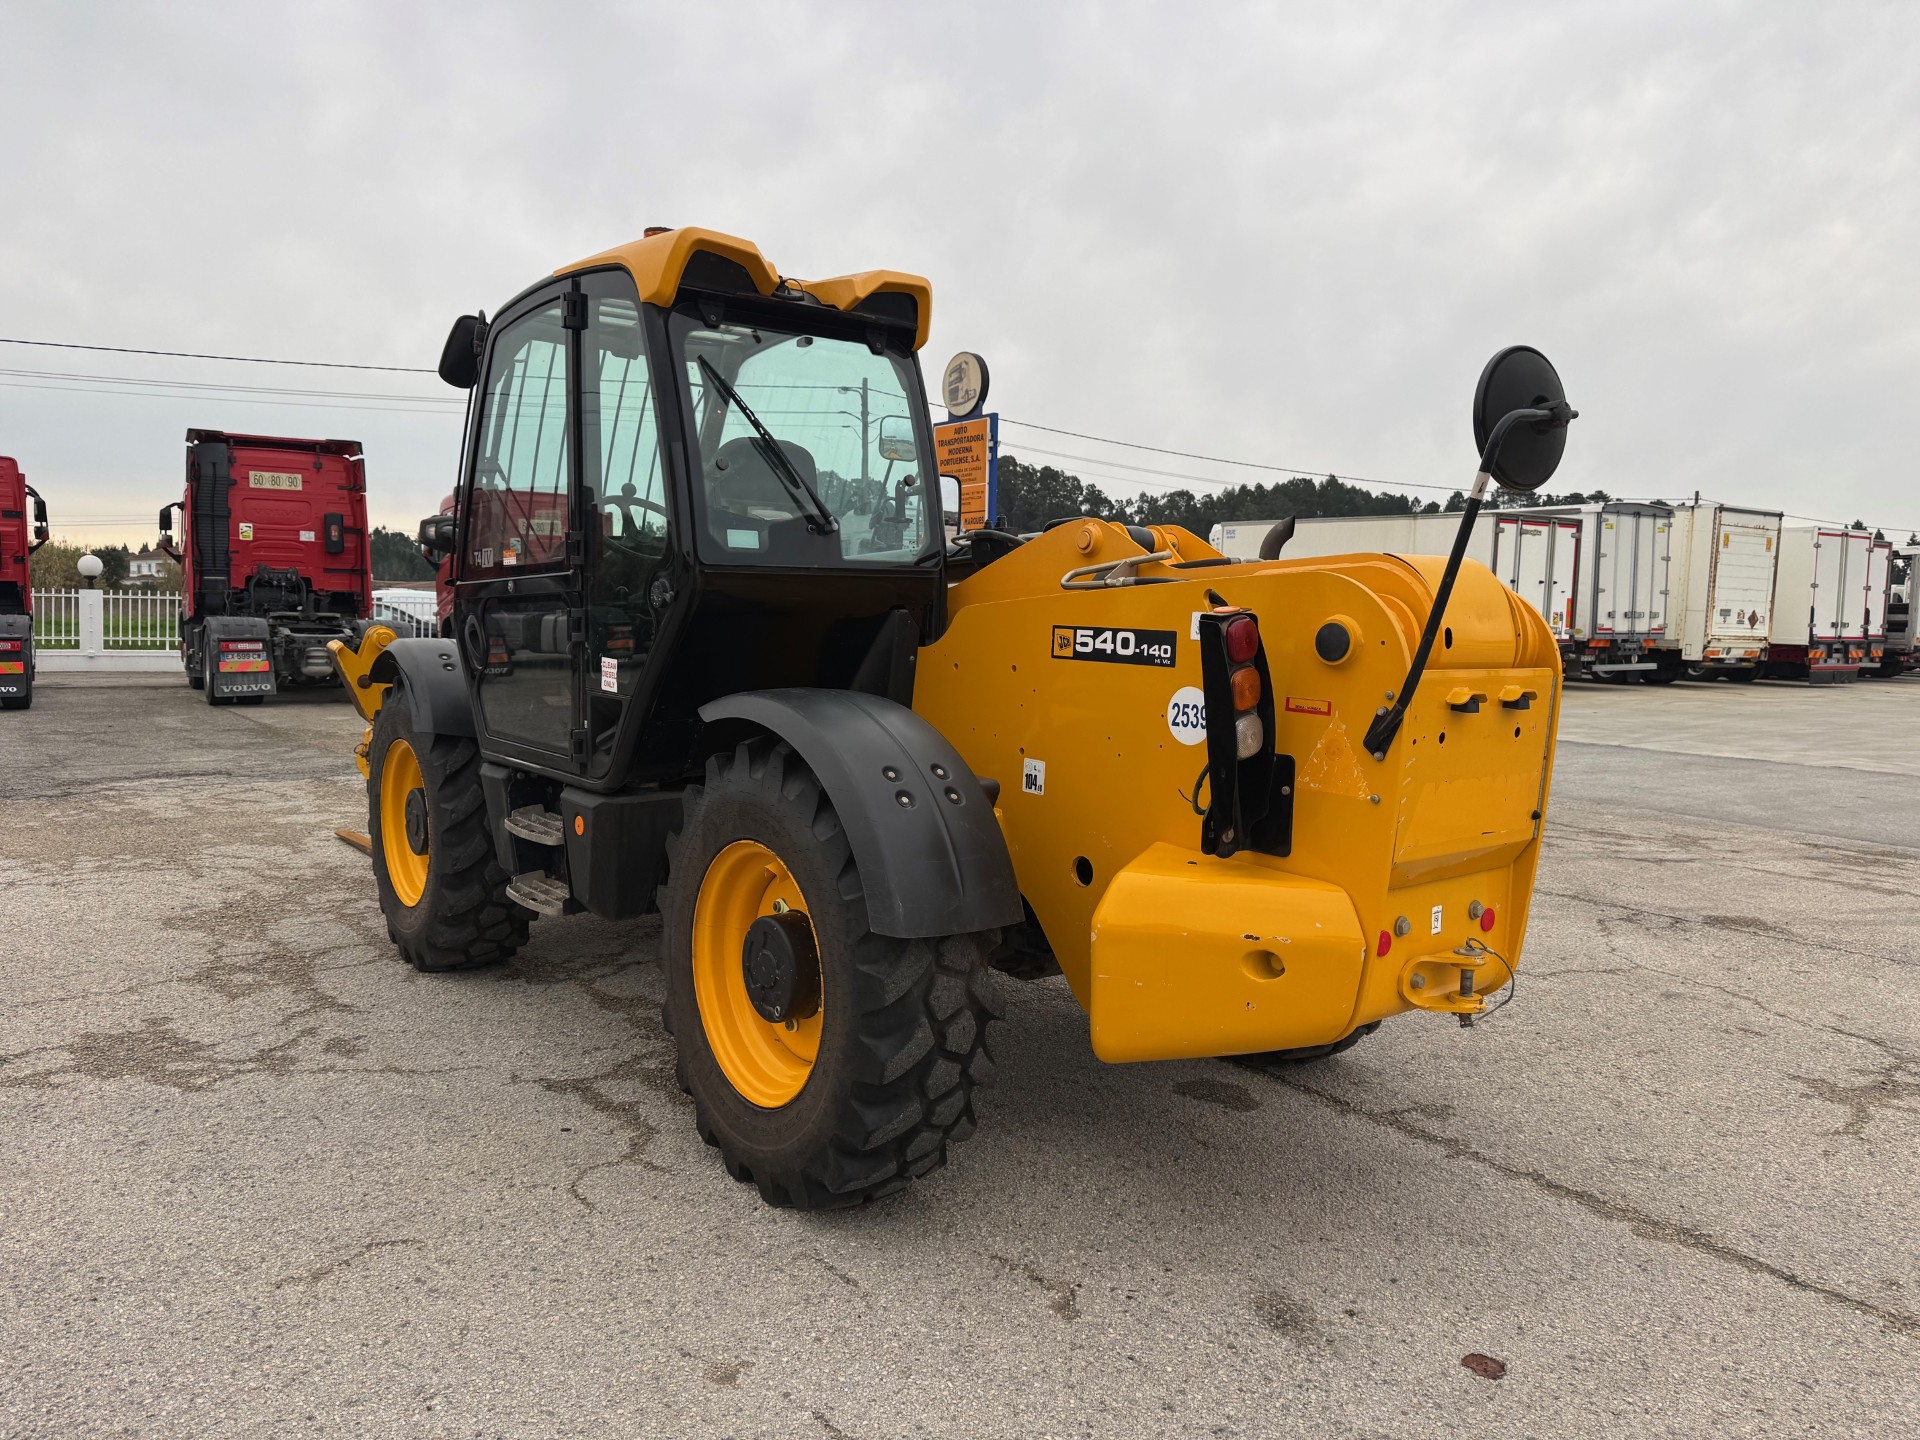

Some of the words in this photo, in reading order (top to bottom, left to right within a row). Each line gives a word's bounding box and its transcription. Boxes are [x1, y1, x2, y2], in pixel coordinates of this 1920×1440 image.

[954, 426, 968, 435] AUTO
[938, 434, 984, 447] TRANSPORTADORA
[948, 446, 973, 456] MODERNA
[253, 474, 264, 486] 60
[270, 475, 281, 487] 80
[287, 476, 298, 488] 90
[1056, 633, 1072, 651] JCB
[602, 660, 617, 670] CLEAN
[602, 670, 617, 680] DIESEL
[220, 683, 271, 693] VOLVO
[603, 679, 615, 689] ONLY
[1171, 702, 1207, 730] 2539
[1025, 772, 1038, 791] 104
